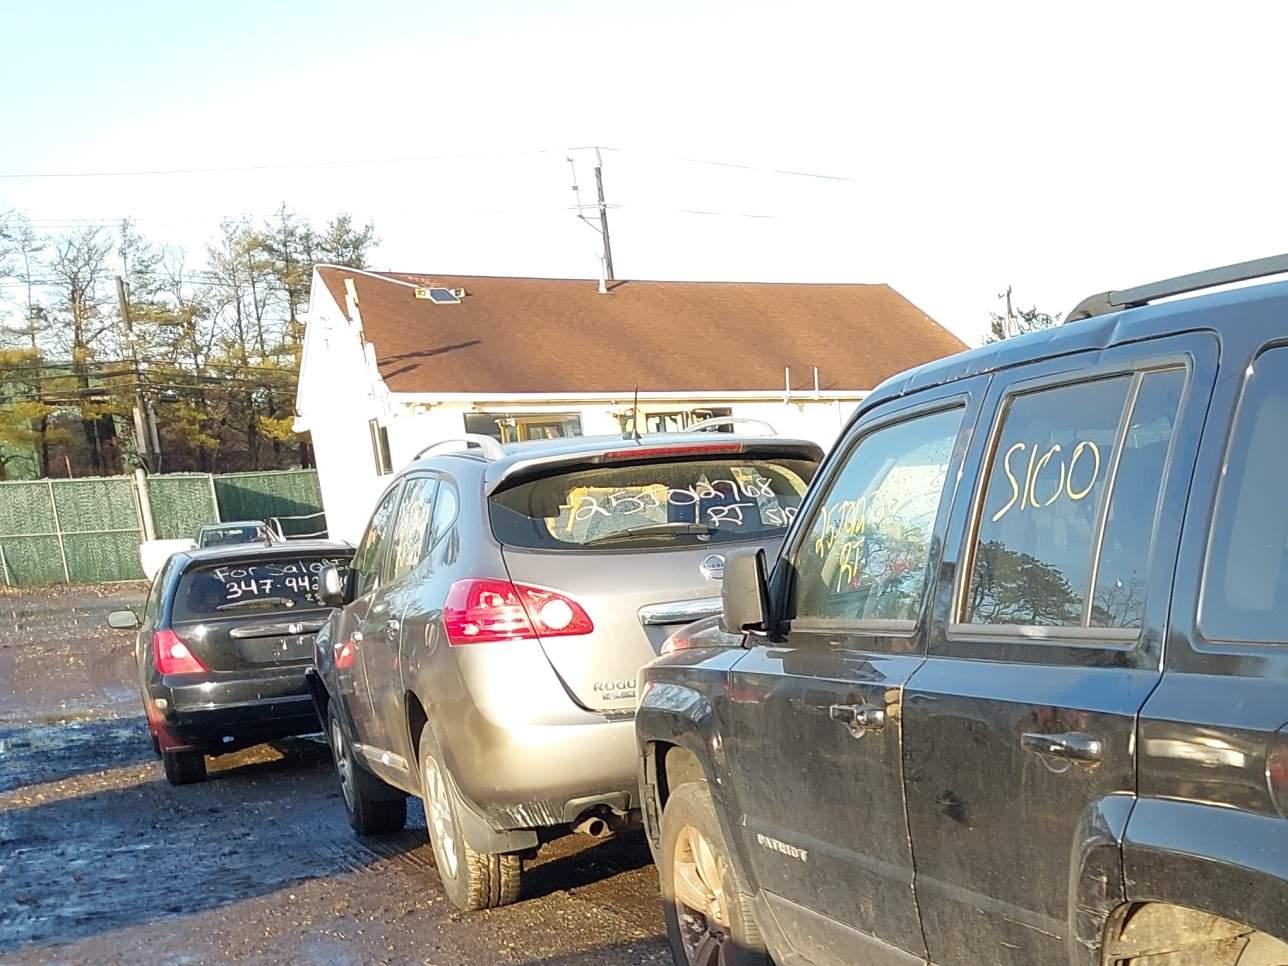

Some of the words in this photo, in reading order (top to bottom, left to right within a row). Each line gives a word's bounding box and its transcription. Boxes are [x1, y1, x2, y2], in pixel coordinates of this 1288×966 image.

[992, 440, 1100, 522] S100
[707, 502, 755, 527] RT
[214, 566, 259, 583] For
[757, 833, 808, 864] PATRIOT
